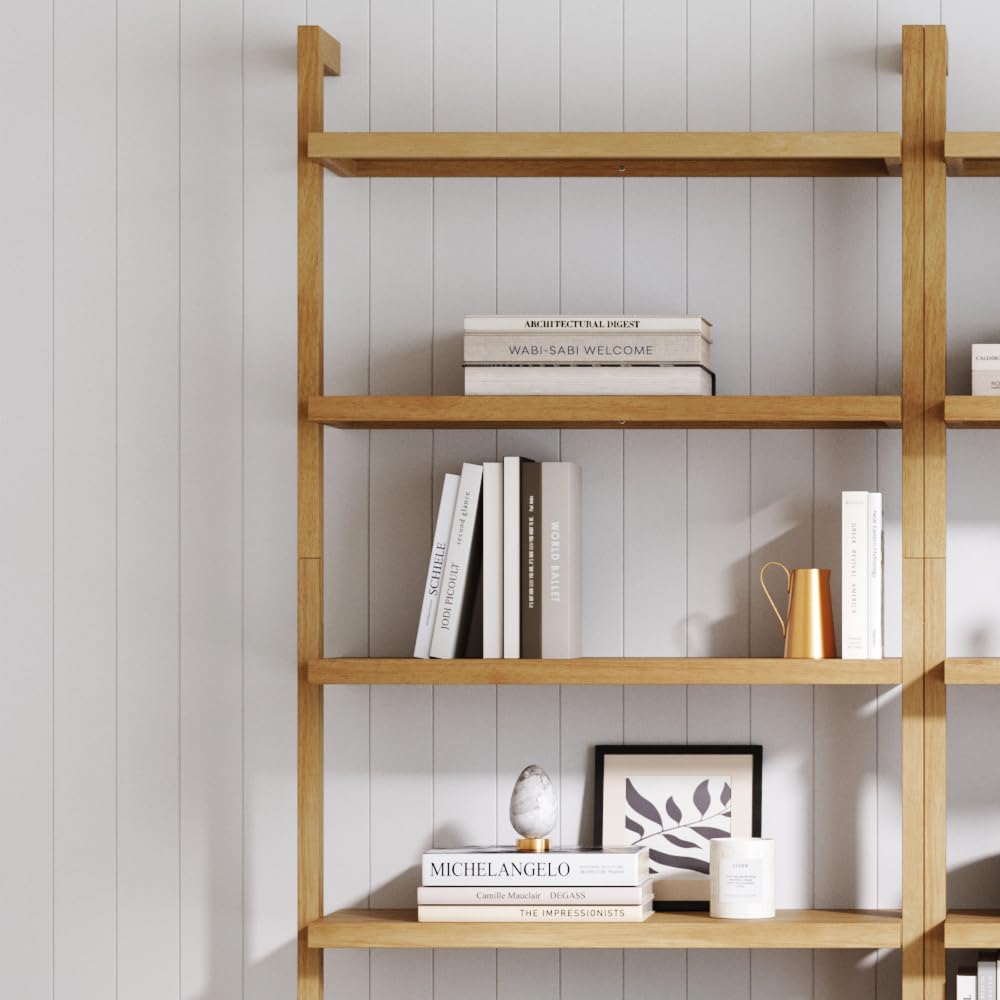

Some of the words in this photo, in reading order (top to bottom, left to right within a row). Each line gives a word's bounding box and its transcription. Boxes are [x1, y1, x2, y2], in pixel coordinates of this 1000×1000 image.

[524, 320, 605, 329] ARCHITECTURAL
[606, 320, 641, 329] DIGEST
[508, 345, 579, 355] WABI-SABI
[583, 345, 653, 355] WELCOME
[461, 490, 470, 517] glance
[457, 518, 466, 545] second
[551, 521, 560, 560] WORLD
[429, 542, 446, 596] SCHIELE
[445, 562, 459, 605] PICOULT
[551, 565, 560, 602] BALLET
[441, 607, 452, 630] JODI
[430, 862, 570, 877] MICHELANGELO
[476, 891, 506, 899] Camille
[508, 891, 541, 899] Mauclair
[550, 891, 586, 899] DEGASS
[520, 909, 538, 917] THE
[542, 909, 625, 917] IMPRESSIONISTS
